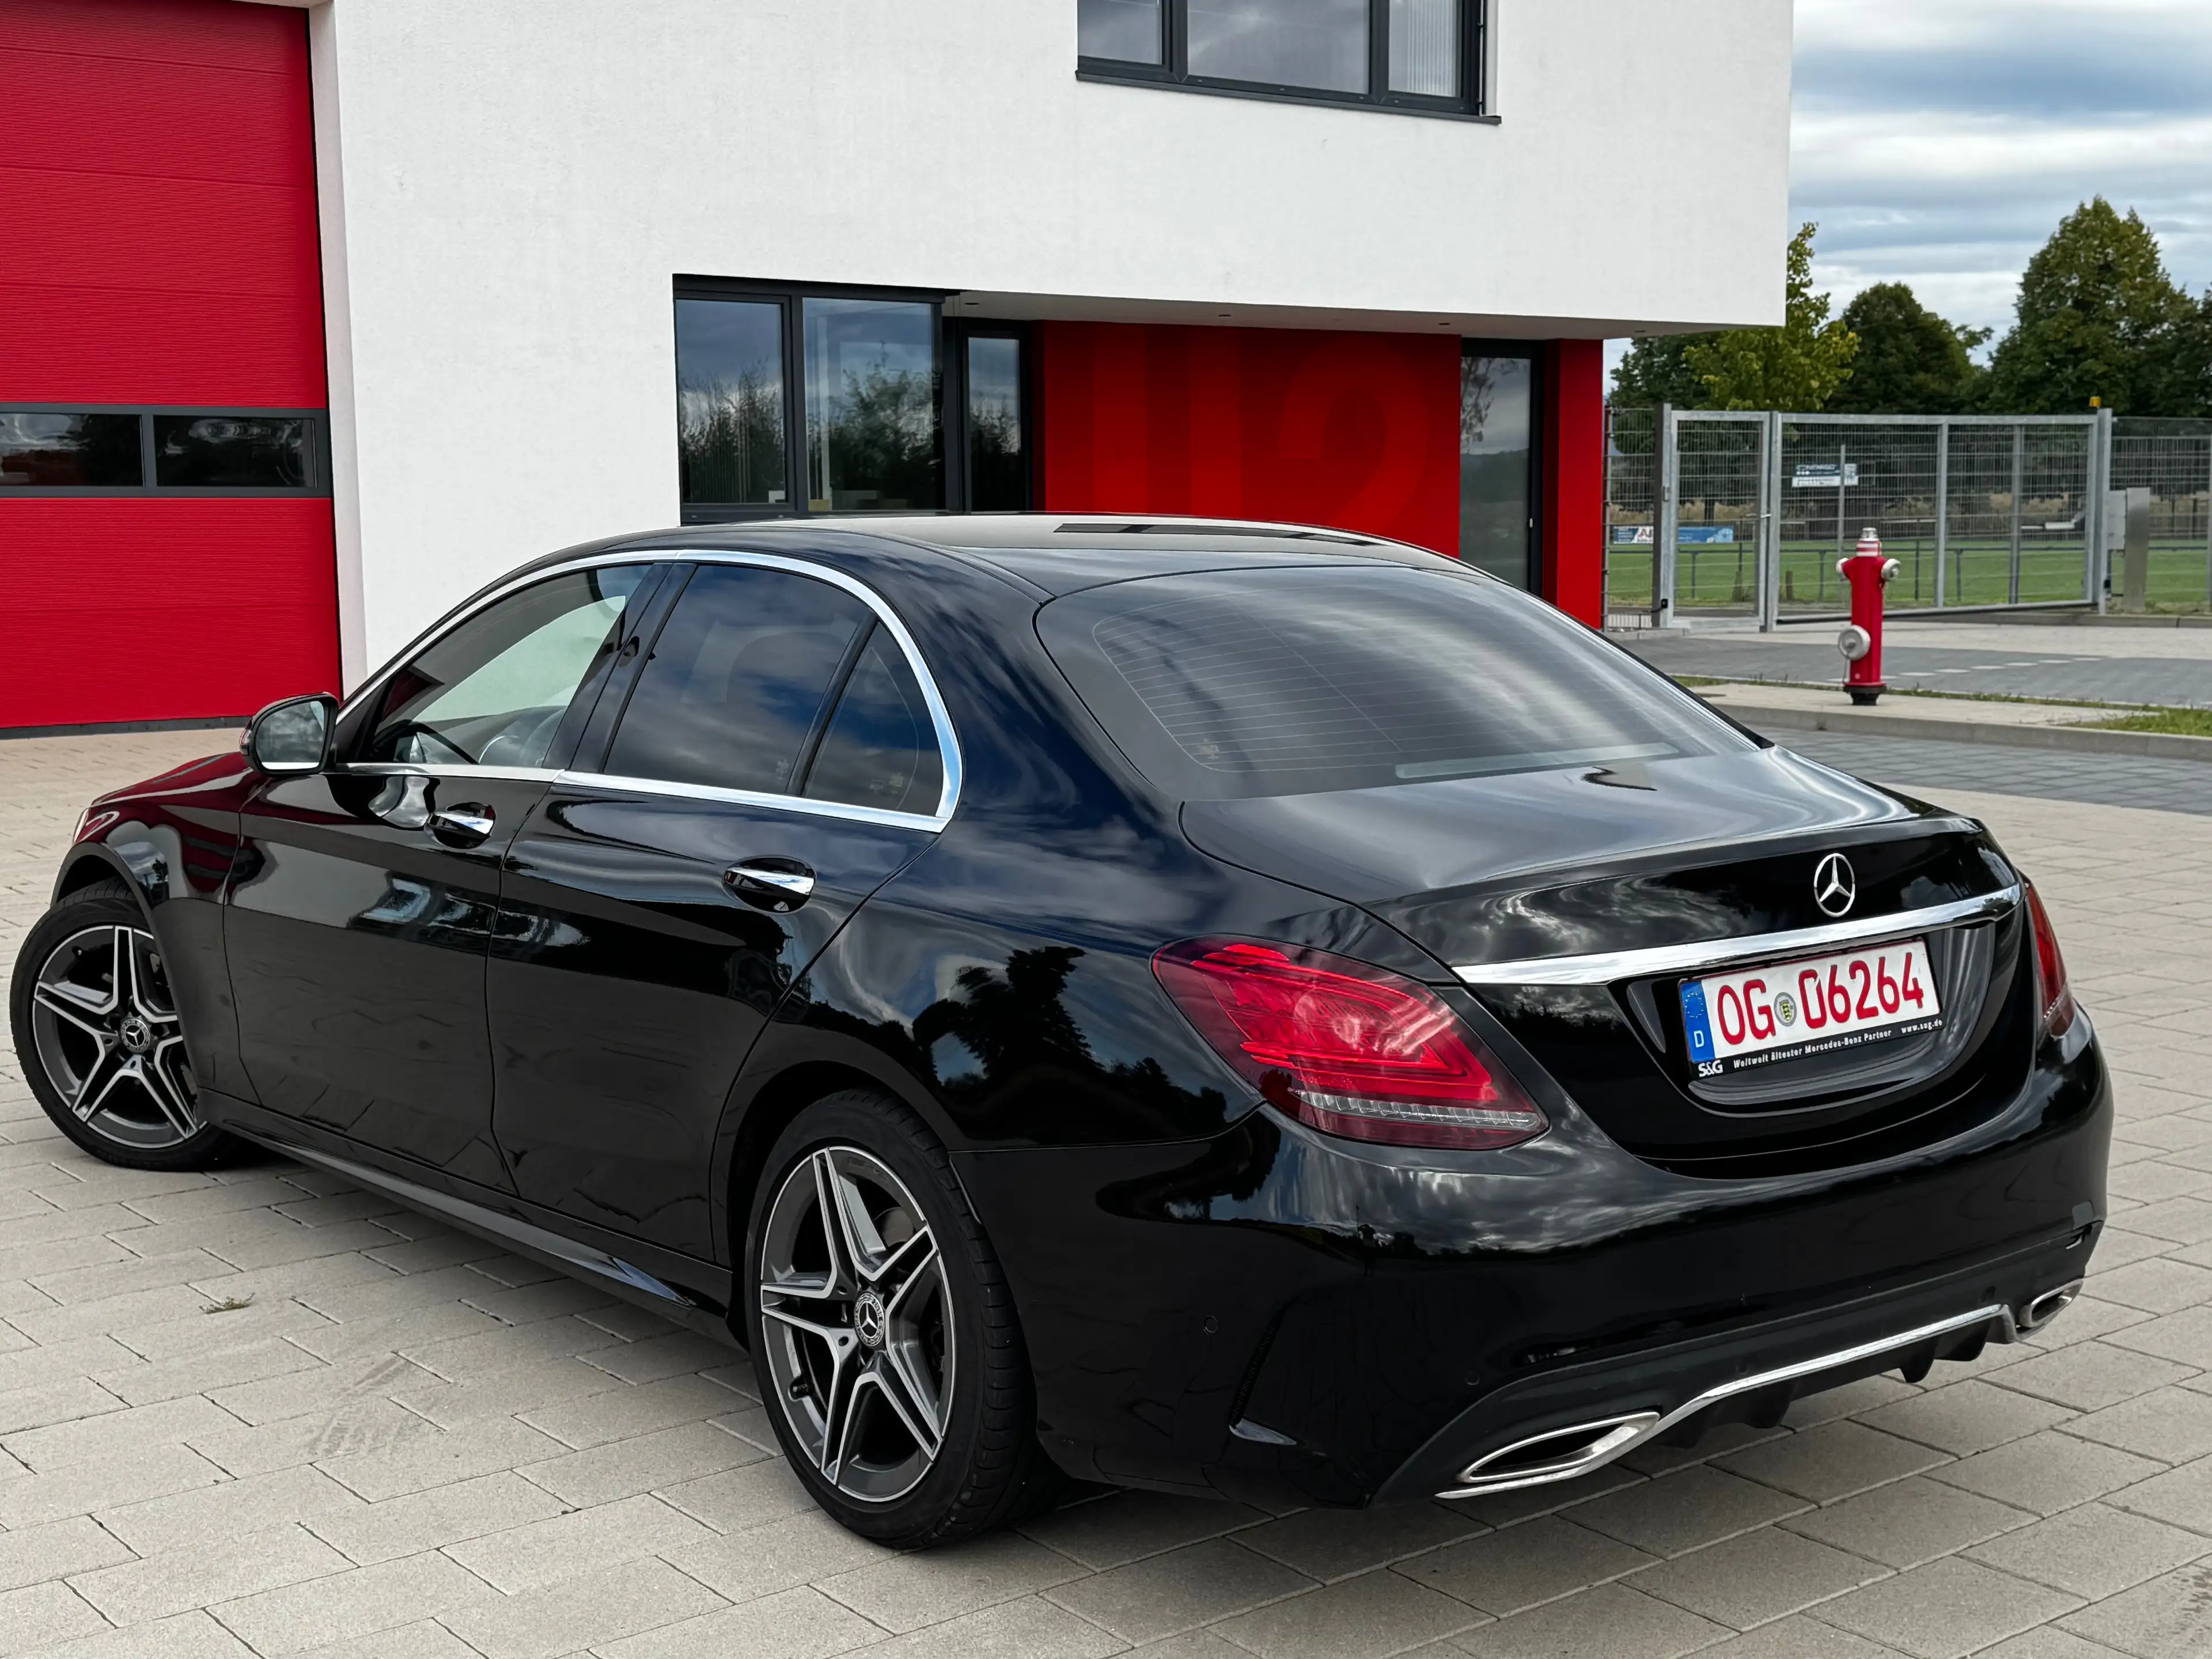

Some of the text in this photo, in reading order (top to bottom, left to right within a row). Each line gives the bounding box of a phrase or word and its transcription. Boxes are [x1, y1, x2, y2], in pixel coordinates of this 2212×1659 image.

[1717, 952, 1924, 1045] OG 06264
[1694, 1030, 1704, 1047] D
[1733, 1054, 1768, 1068] Weltweit
[1805, 1036, 1862, 1054] Mercedes-Benz
[1863, 1030, 1892, 1042] Partner
[1698, 1060, 1723, 1077] S&G
